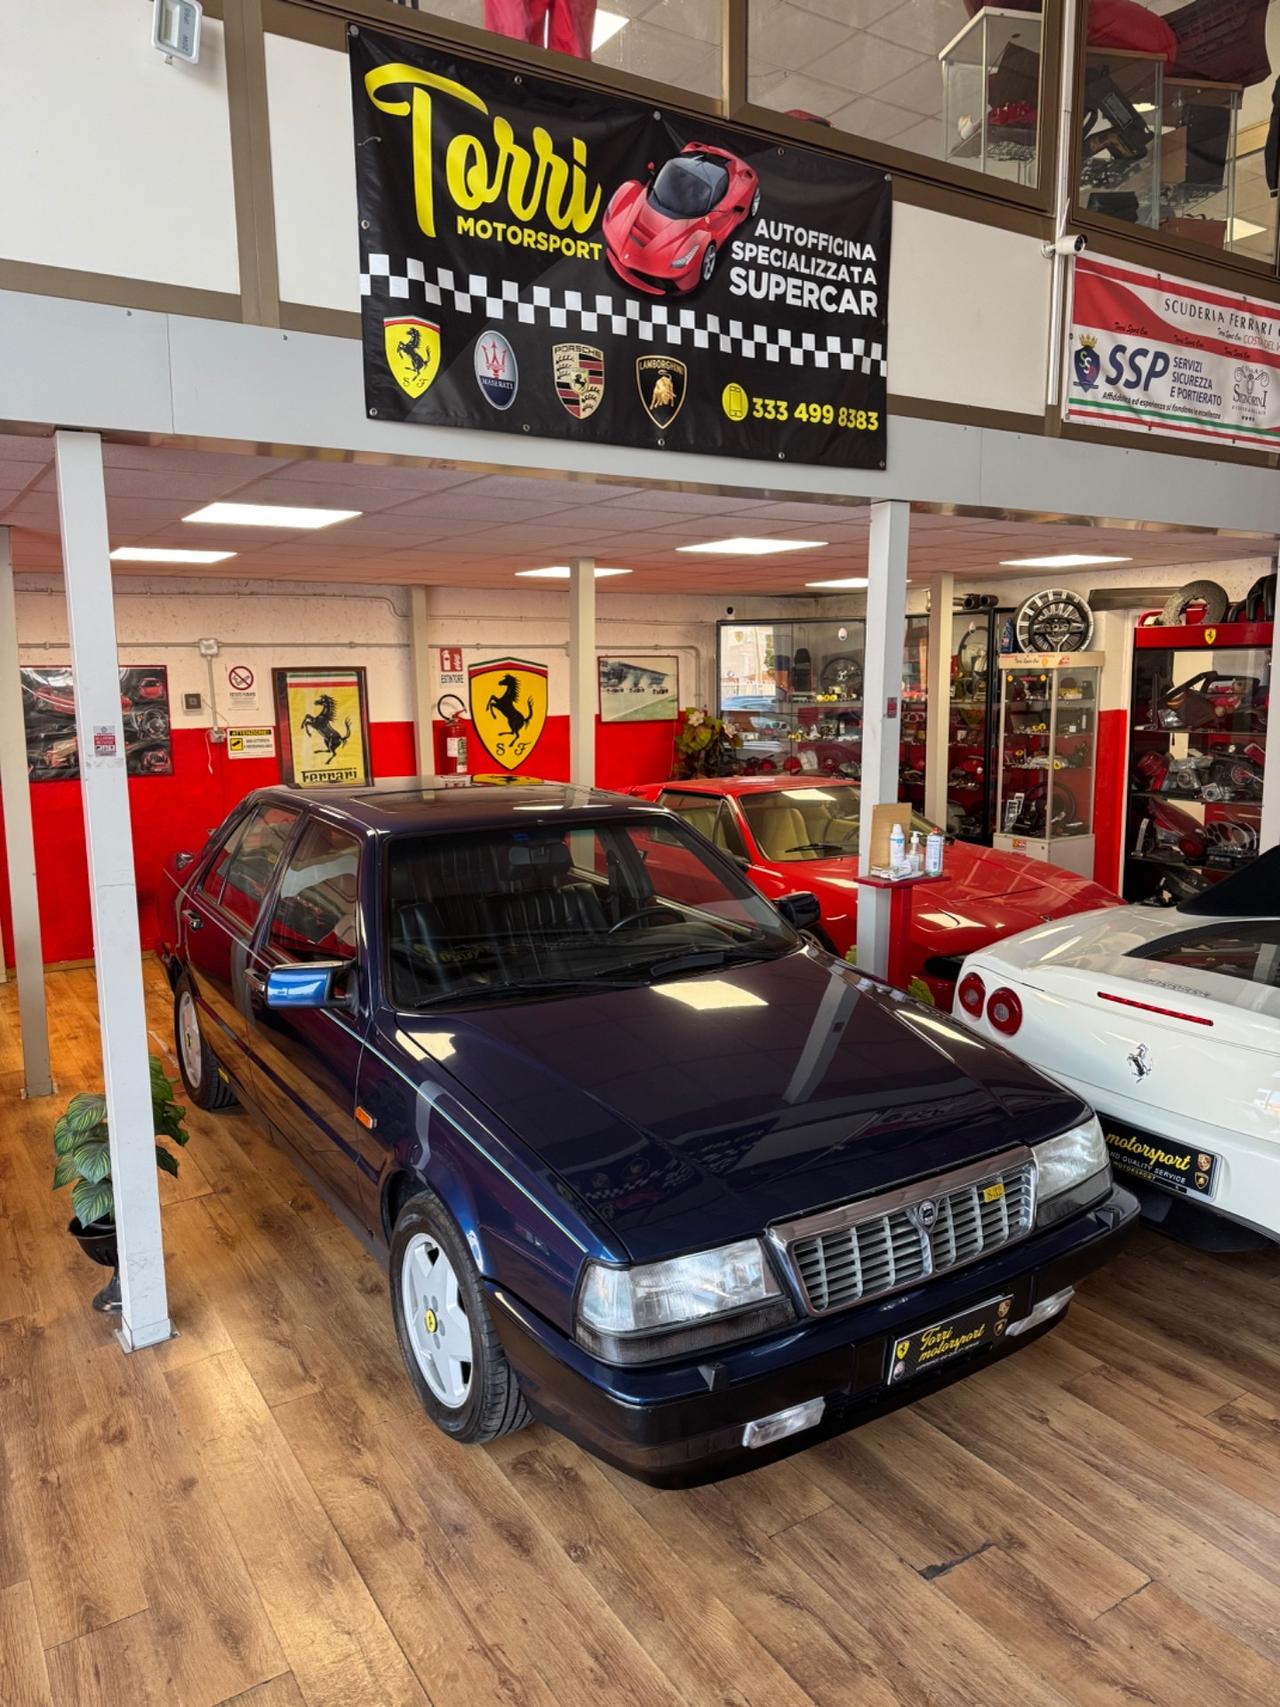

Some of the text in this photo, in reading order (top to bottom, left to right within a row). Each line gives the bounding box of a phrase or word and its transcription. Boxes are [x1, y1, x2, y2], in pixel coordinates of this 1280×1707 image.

[364, 62, 602, 238] Torri
[456, 215, 602, 260] MOTORSPORT
[754, 218, 877, 262] AUTOFFICINA
[731, 240, 877, 286] SPECIALIZZATA
[729, 266, 878, 318] SUPERCAR
[1164, 298, 1225, 323] SCUDERIA
[1229, 313, 1273, 336] FERRARI
[553, 344, 602, 359] PORSCHE
[1173, 356, 1203, 373] SERVIZI
[638, 359, 685, 376] LAMBORGHINI
[1105, 344, 1170, 392] SSP
[1172, 371, 1213, 390] SICUREZZA
[481, 377, 514, 391] MASERATI
[1169, 386, 1222, 407] E PORTIERATO
[752, 397, 879, 431] 333 499 8383
[496, 743, 505, 756] S
[301, 768, 357, 782] Ferrari
[1106, 1133, 1192, 1171] motorsport
[1122, 1156, 1153, 1172] QUALITY
[1153, 1167, 1187, 1185] SERVICE
[918, 1323, 986, 1363] motorsport
[919, 1326, 954, 1351] Torri
